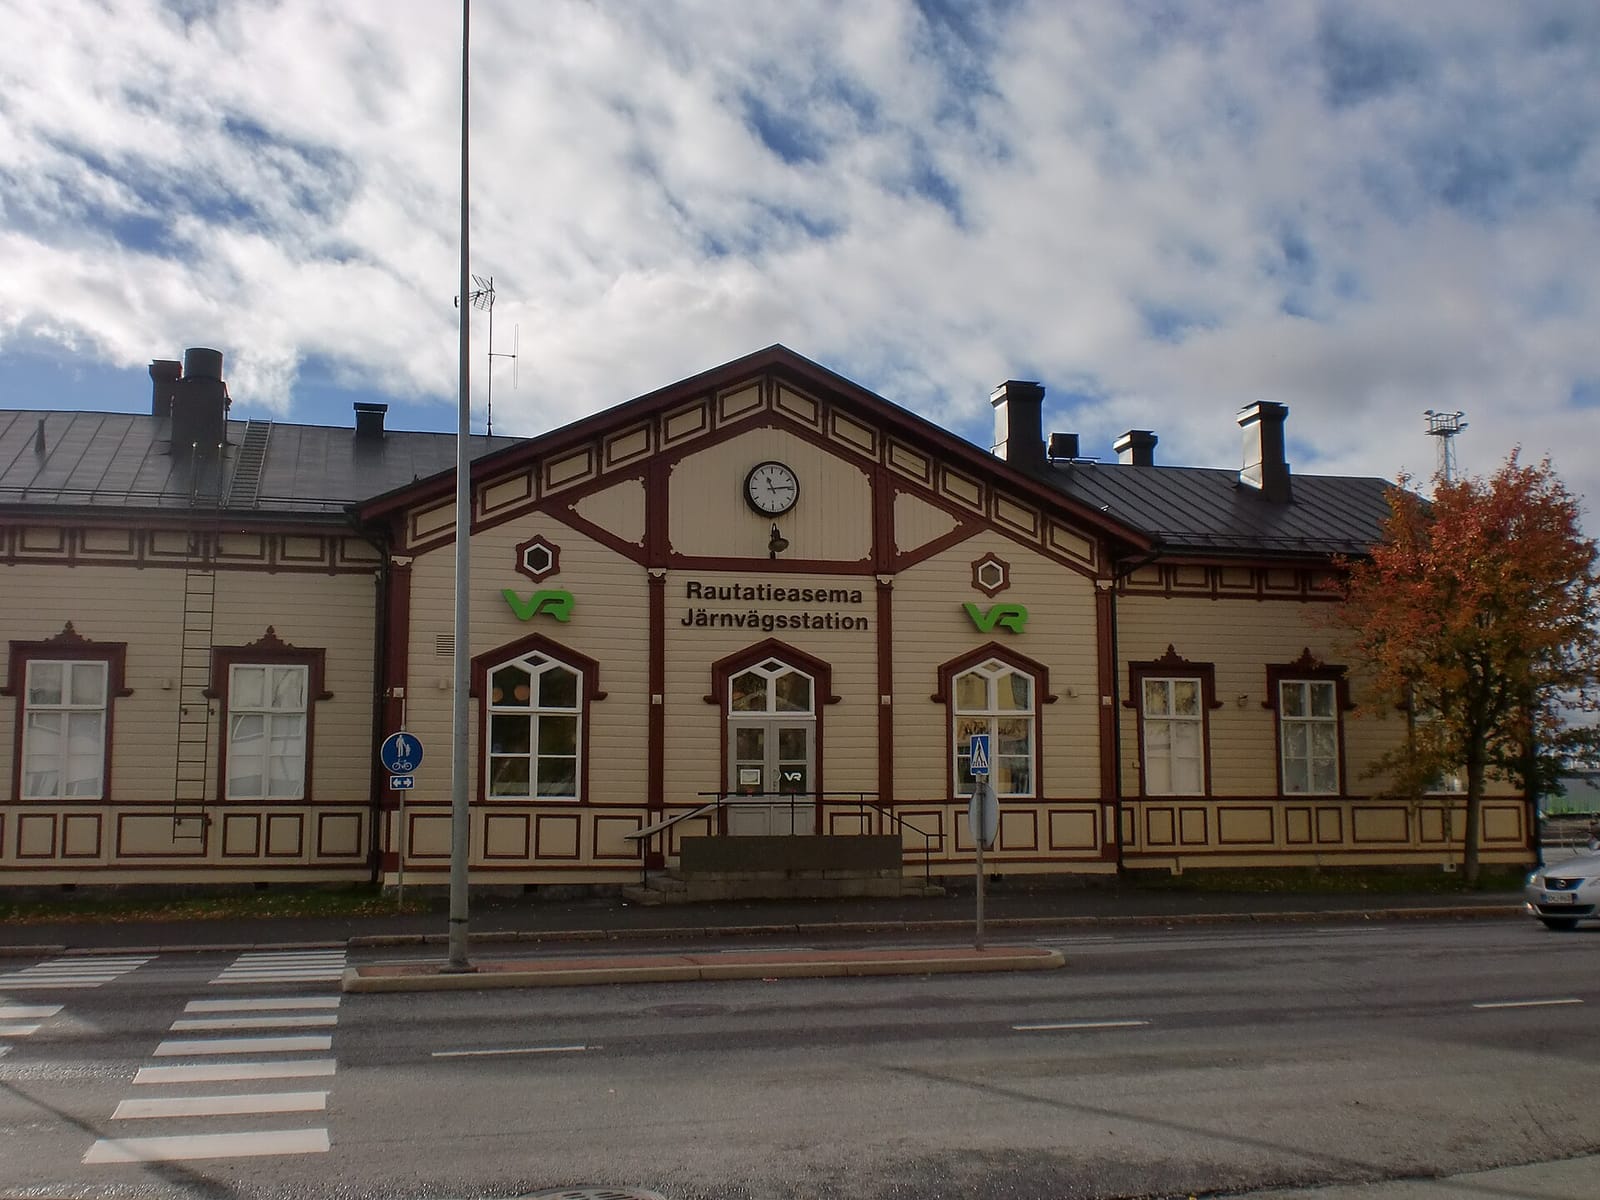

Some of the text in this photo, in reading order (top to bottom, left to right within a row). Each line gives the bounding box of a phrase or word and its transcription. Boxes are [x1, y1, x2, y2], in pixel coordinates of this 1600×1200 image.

[501, 588, 574, 622] VR
[686, 581, 862, 603] Rautatieasema
[681, 608, 868, 632] Järnvägsstation
[961, 602, 1028, 633] VR
